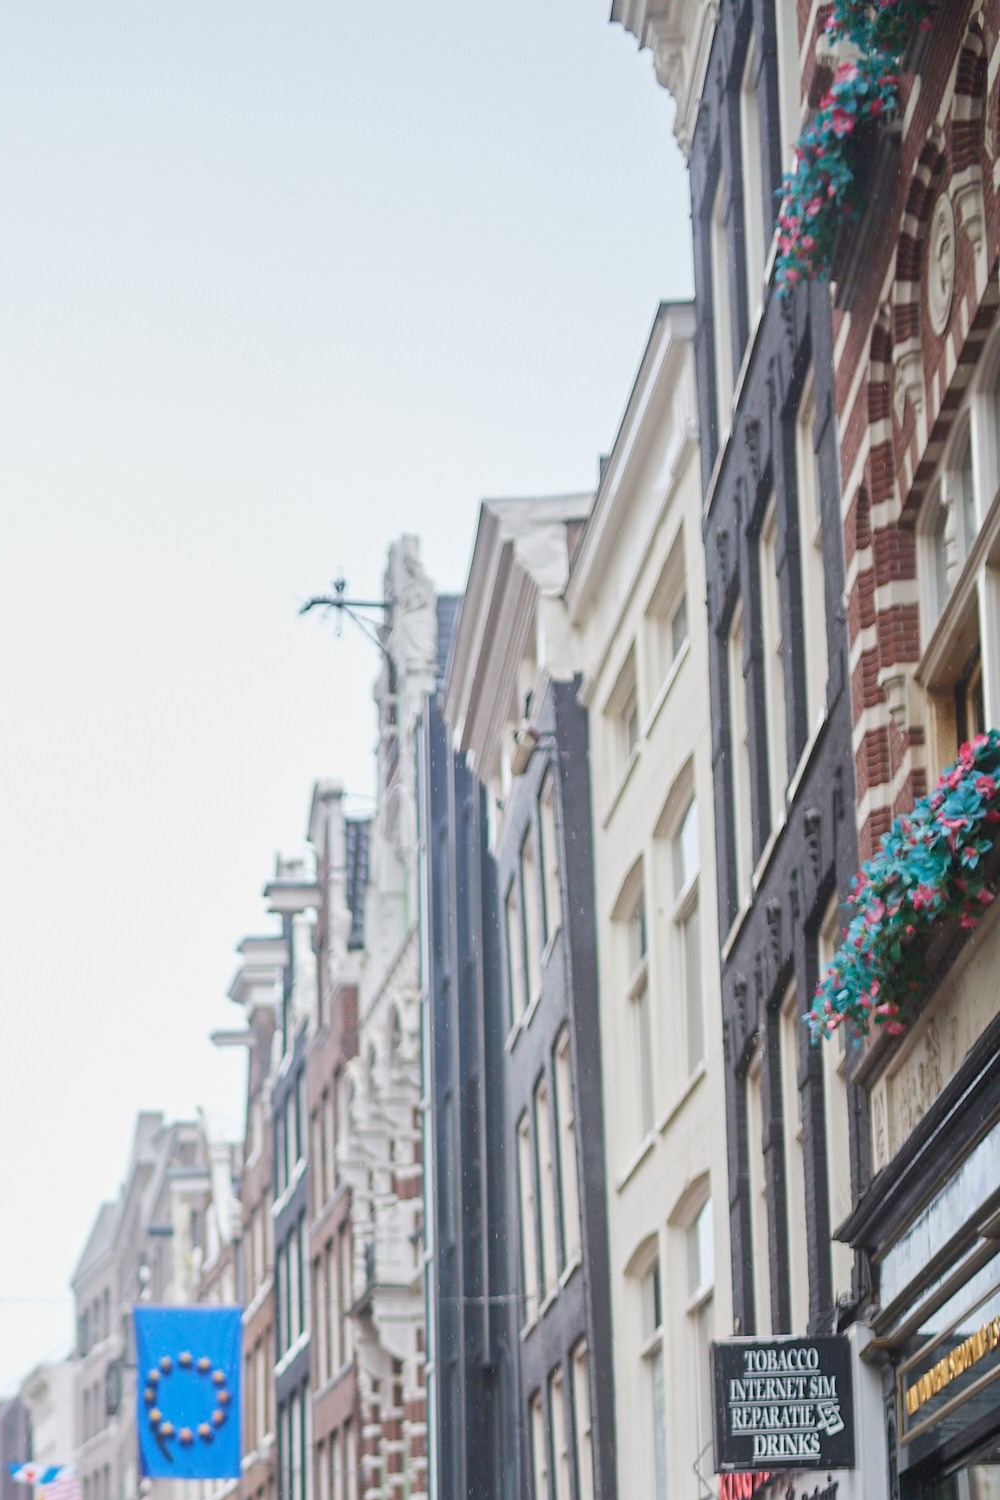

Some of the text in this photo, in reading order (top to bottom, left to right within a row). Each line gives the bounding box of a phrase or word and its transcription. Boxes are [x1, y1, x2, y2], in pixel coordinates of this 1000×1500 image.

[744, 1348, 820, 1371] TOBACCO
[730, 1375, 838, 1401] INTERNET SIM
[732, 1404, 815, 1429] REPARATIE
[753, 1433, 821, 1456] DRINKS
